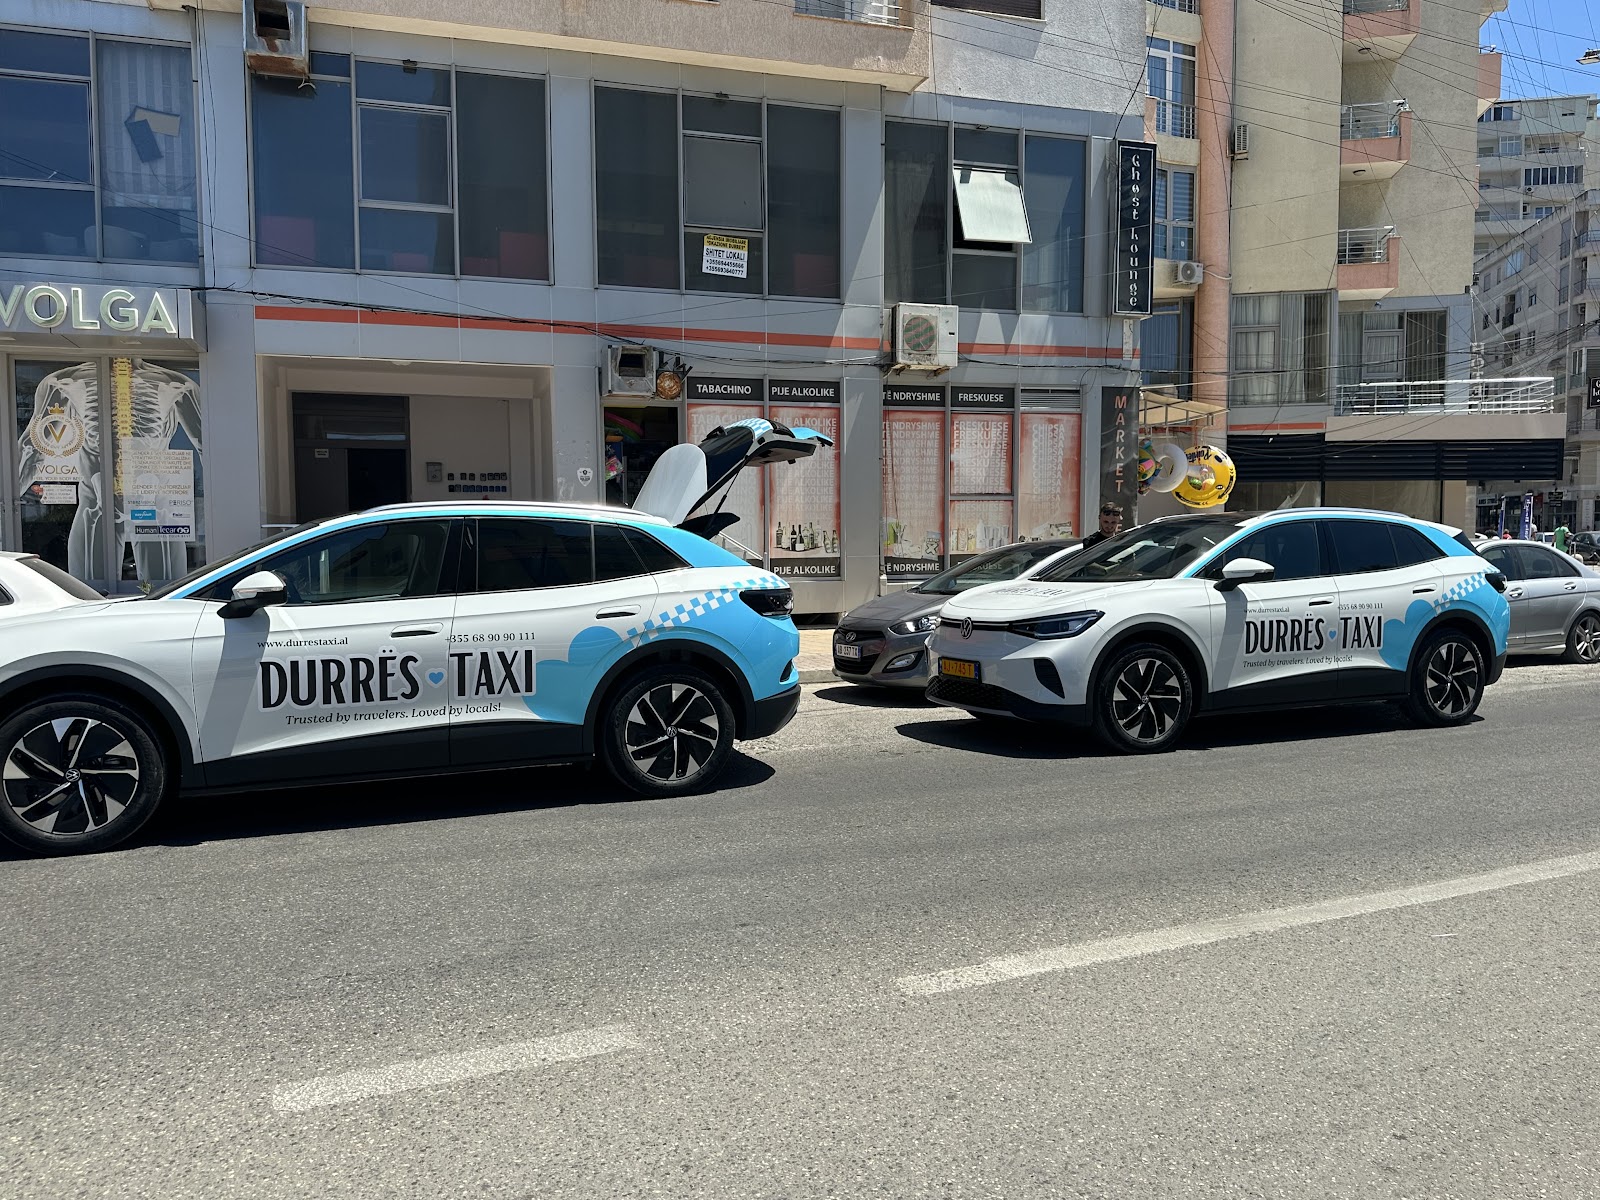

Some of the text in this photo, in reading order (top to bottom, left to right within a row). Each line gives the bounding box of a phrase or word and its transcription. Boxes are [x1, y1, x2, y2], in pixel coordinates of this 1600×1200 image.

[1131, 154, 1141, 220] Ghost
[706, 248, 746, 260] SHITET LOKALI
[0, 284, 177, 334] VOLGA
[696, 384, 752, 394] TABACHINO
[771, 386, 835, 397] PIJE ALKOLIKE
[893, 391, 941, 401] NDRYSHME
[958, 393, 1004, 402] FRESKUESE
[794, 418, 837, 427] ALKOLIKE
[954, 422, 1008, 431] FRESKUESE
[1032, 424, 1064, 432] CHIPSA
[954, 431, 1008, 440] FRESKUESE
[1032, 432, 1064, 440] CHIPSA
[954, 440, 1008, 449] FRESKUESE
[1114, 396, 1127, 492] MARKET
[38, 465, 78, 474] VOLGA
[954, 468, 1006, 476] FRESKUESE
[955, 477, 1005, 486] FRESKUESE
[774, 565, 836, 575] PIJE ALKOLIKE
[894, 562, 940, 572] NDRYSHME
[445, 632, 536, 643] +355 68 90 90 111
[1246, 614, 1382, 654] DURRËS TAXI
[257, 637, 348, 648] www.durrestaxi.al
[1243, 659, 1266, 668] Trusted
[1268, 659, 1276, 667] by
[1306, 656, 1324, 664] Loved
[1326, 656, 1332, 664] by
[1334, 655, 1352, 663] locals!
[260, 649, 533, 709] DURRËS TAXI
[286, 702, 502, 724] Trusted by travelers. Loved by locals!
